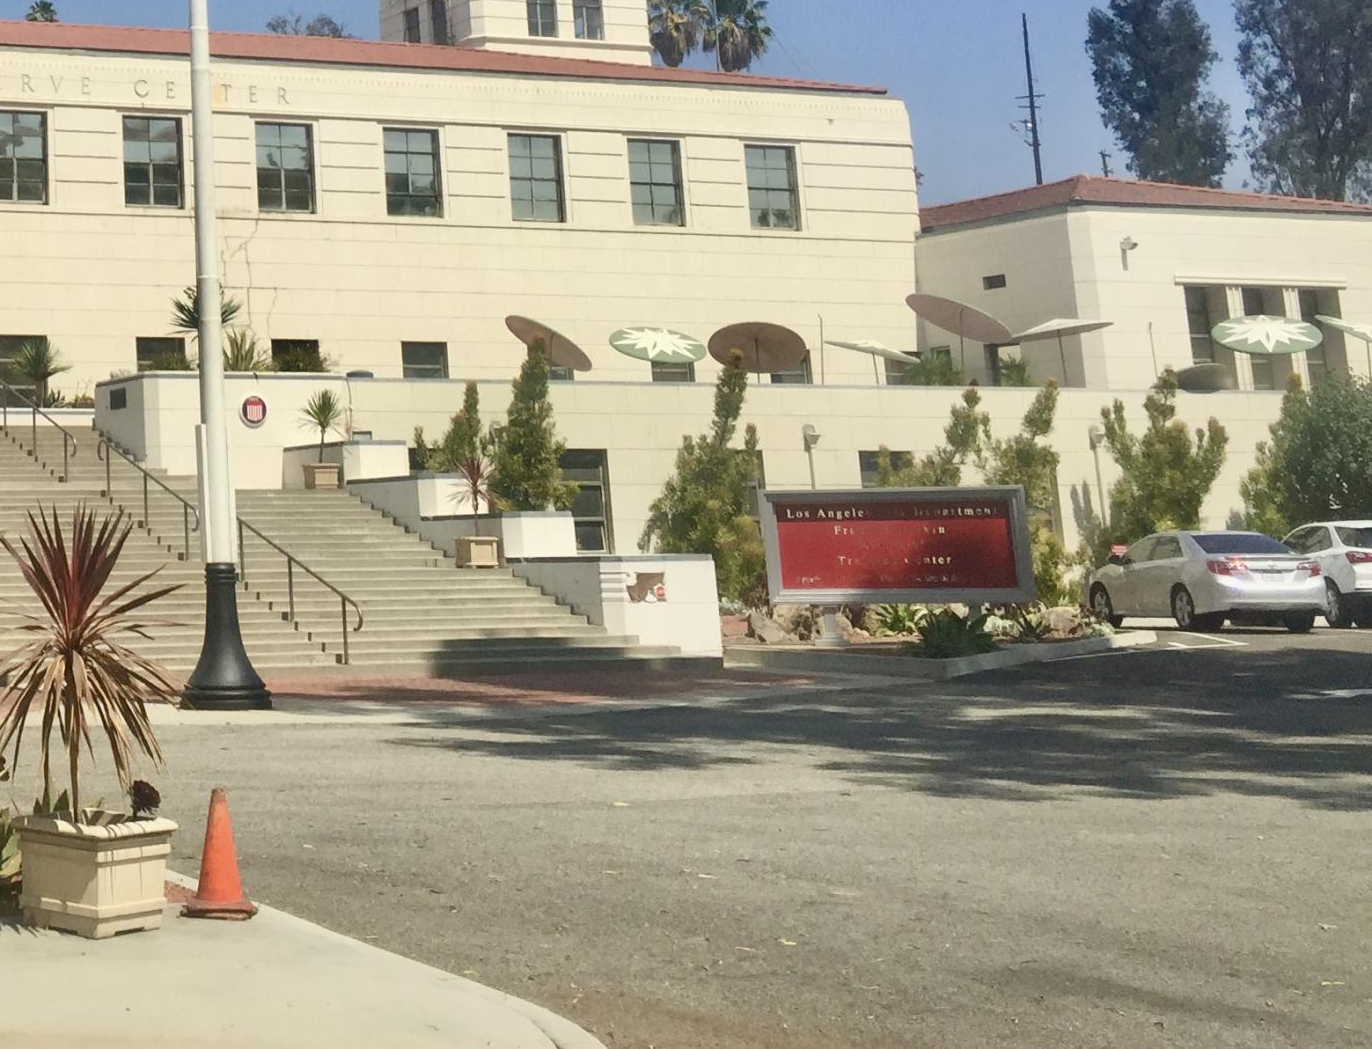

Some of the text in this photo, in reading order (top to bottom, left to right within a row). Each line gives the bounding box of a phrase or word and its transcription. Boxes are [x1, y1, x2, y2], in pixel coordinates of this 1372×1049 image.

[133, 79, 290, 105] CETER
[786, 509, 810, 519] Los
[817, 508, 868, 520] Angele
